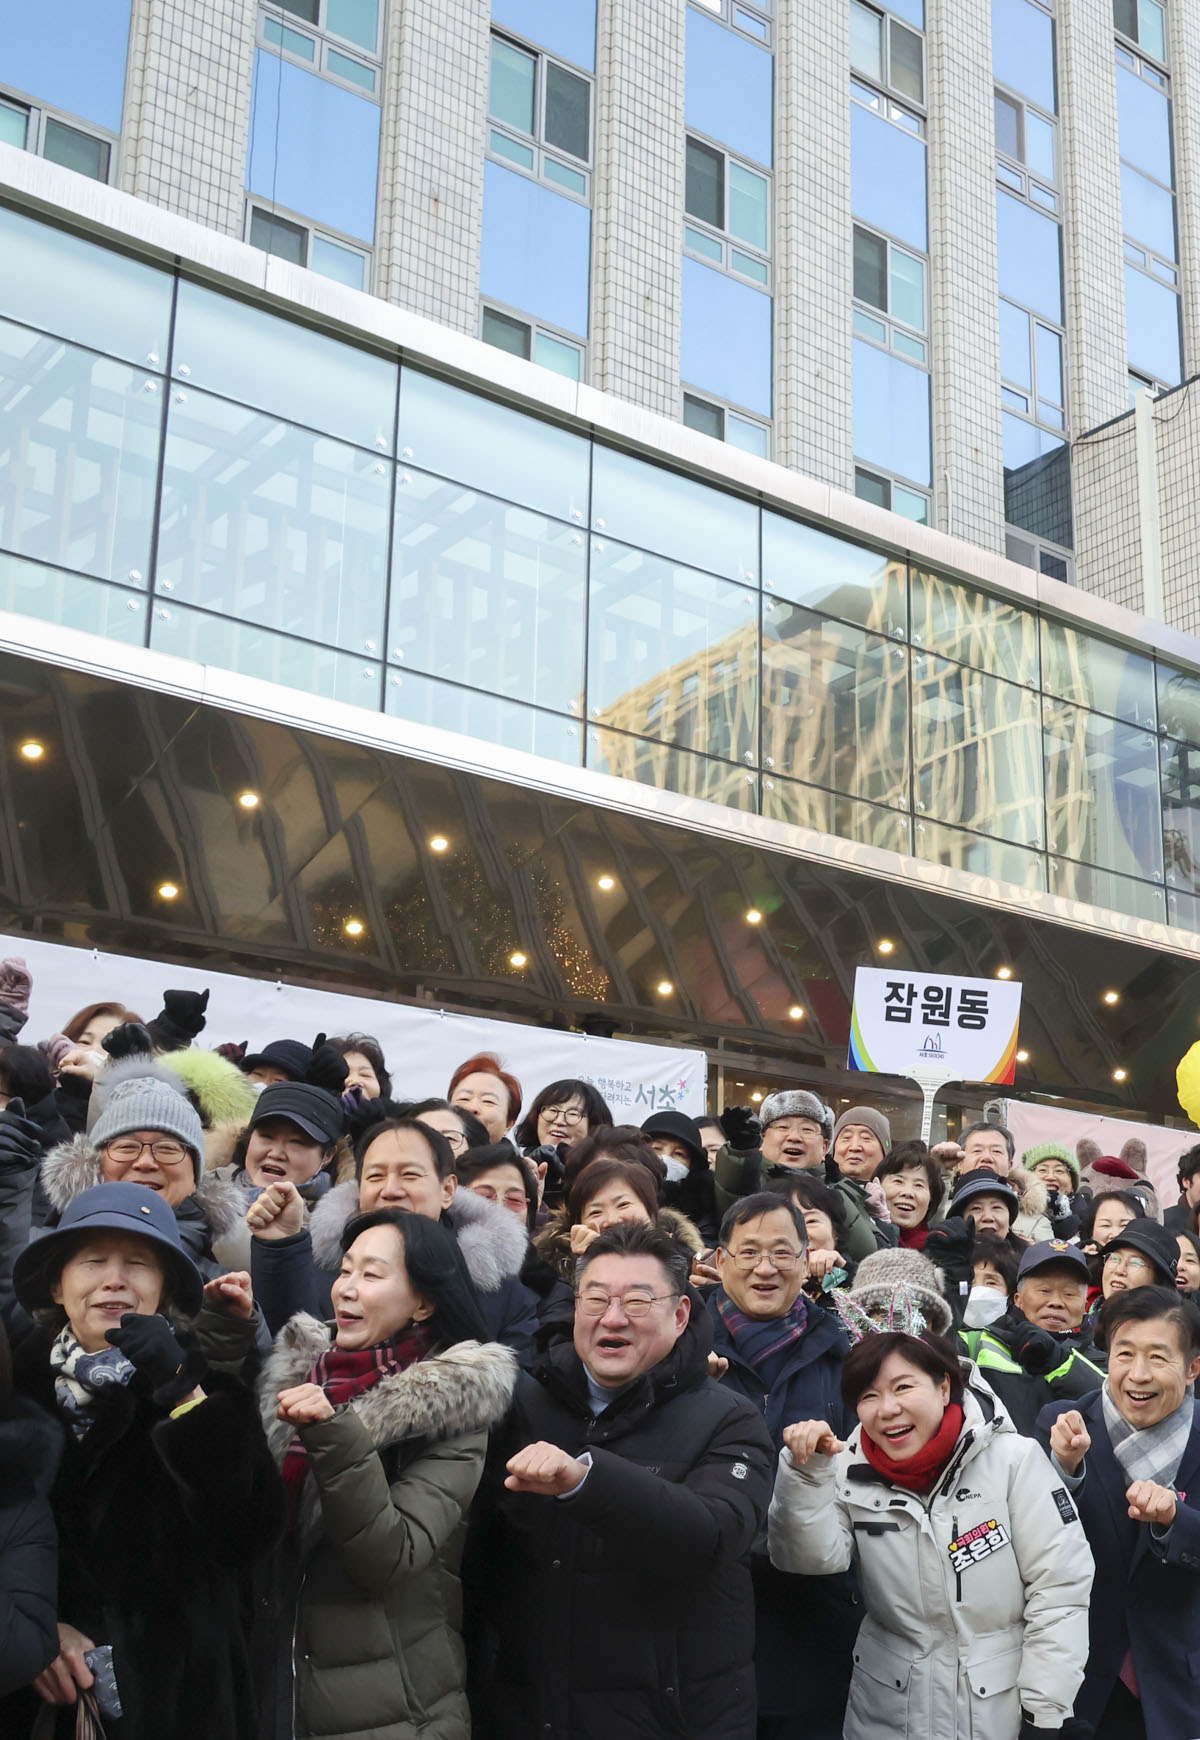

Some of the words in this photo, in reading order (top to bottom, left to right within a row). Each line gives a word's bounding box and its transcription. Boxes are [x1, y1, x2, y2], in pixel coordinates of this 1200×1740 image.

[884, 981, 989, 1030] 잠원동
[597, 1077, 633, 1092] 행복하고
[635, 1083, 678, 1111] 서초
[956, 1522, 990, 1547] 국회의원
[949, 1525, 1010, 1573] 조은희
